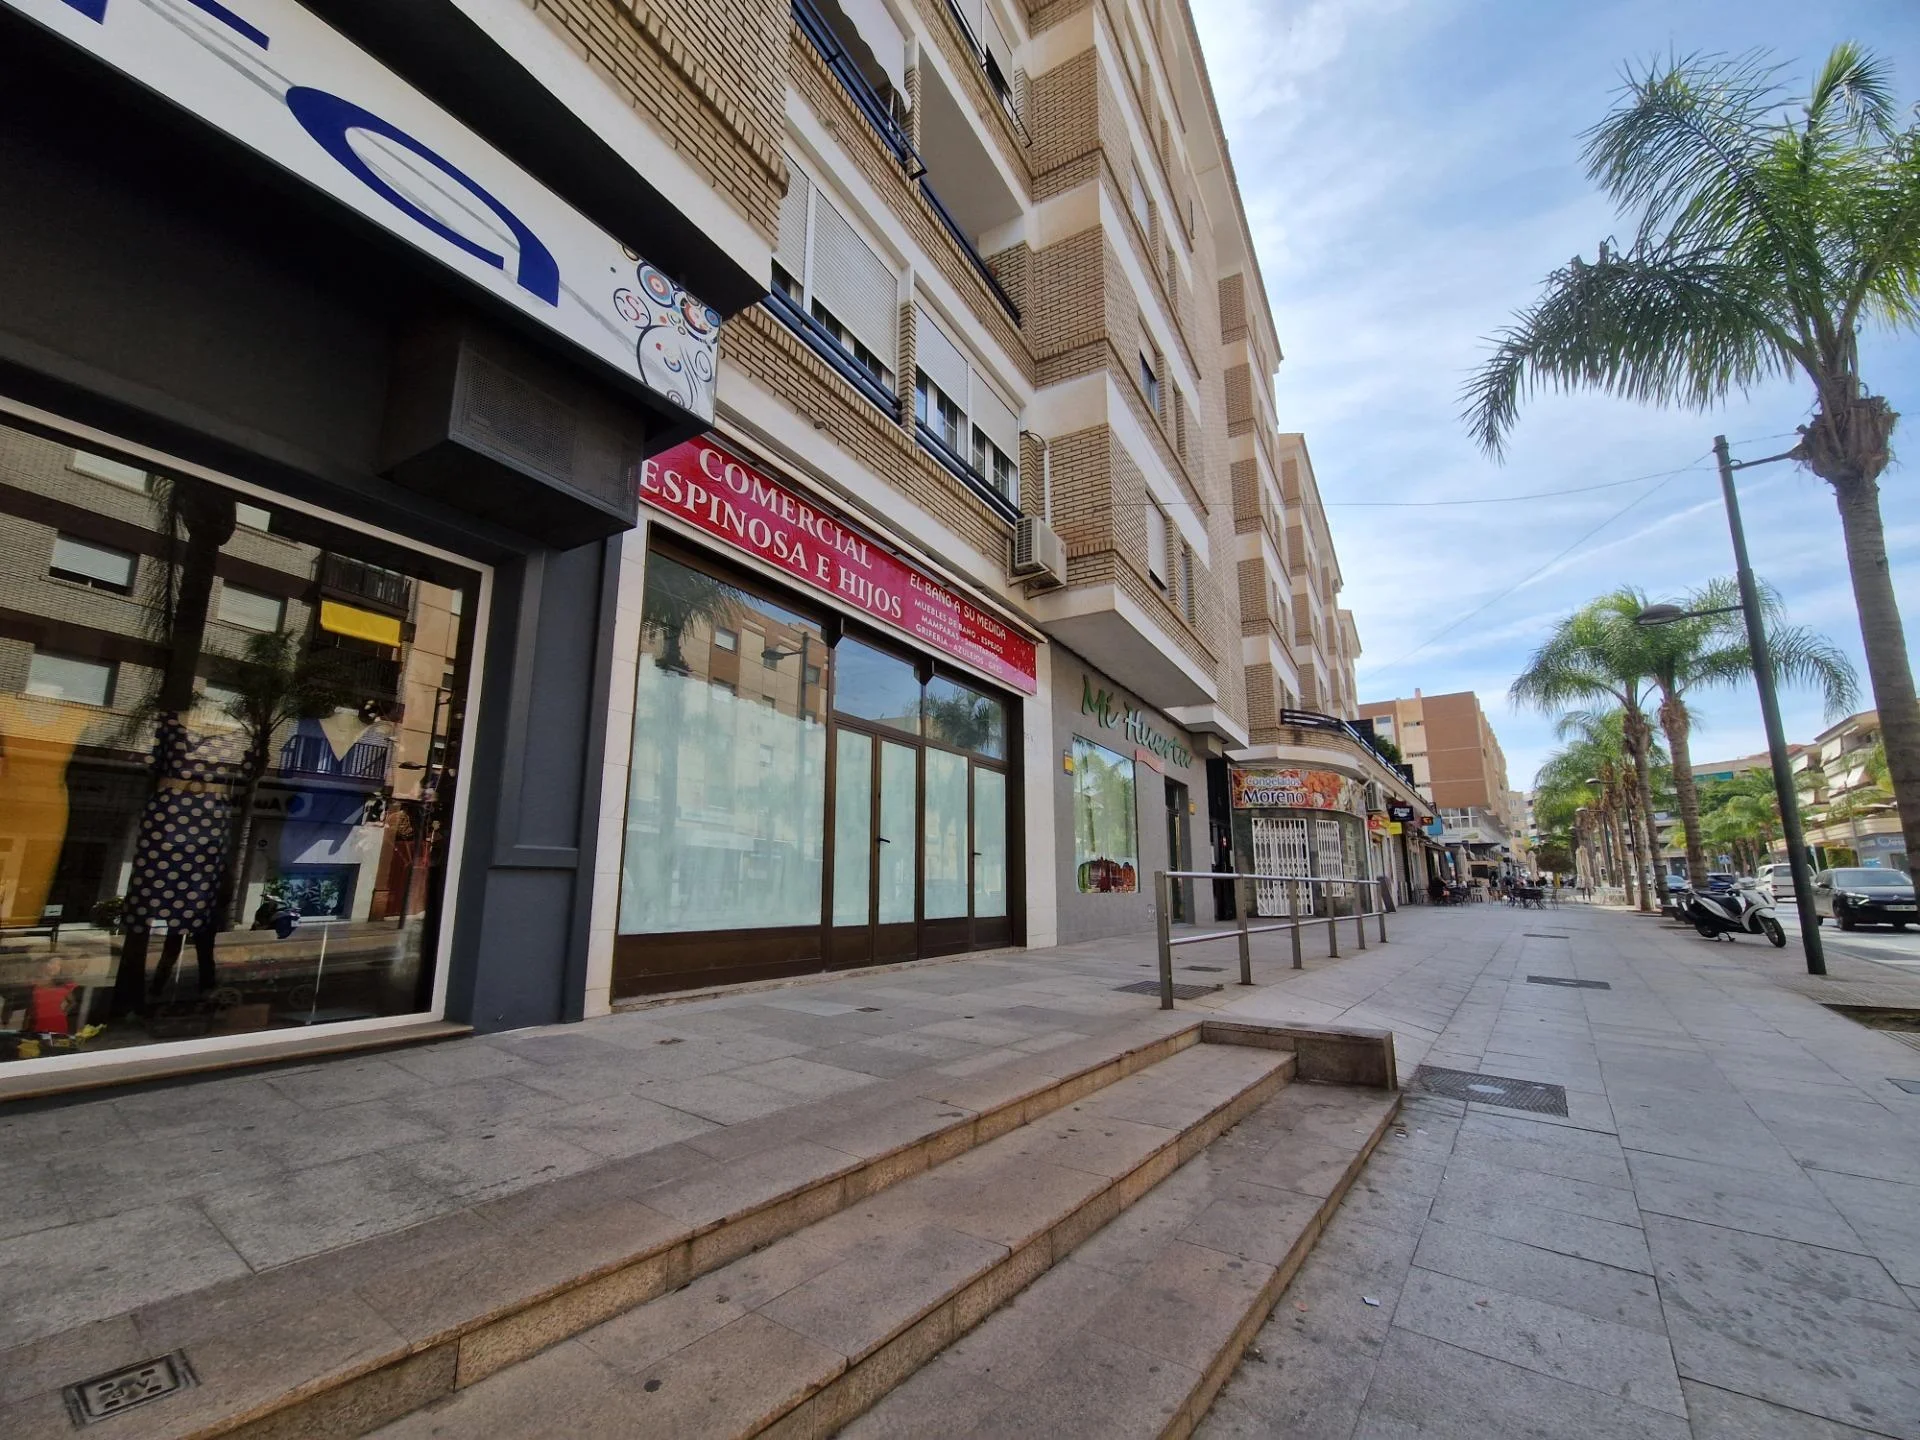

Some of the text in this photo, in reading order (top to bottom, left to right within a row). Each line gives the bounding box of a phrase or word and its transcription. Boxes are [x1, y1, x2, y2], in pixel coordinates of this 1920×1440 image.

[699, 448, 873, 570] COMERCIAL
[640, 459, 903, 620] ESPINOSA E HIJOS
[910, 573, 1006, 640] EL BAÑO A SU MEDIDA
[914, 599, 947, 622] MUEBLES
[948, 617, 958, 628] DE
[921, 615, 960, 641] MAMPARAS
[1081, 673, 1193, 769] Mi Huerta
[1242, 789, 1305, 804] Moreno
[1246, 775, 1301, 787] Congelados
